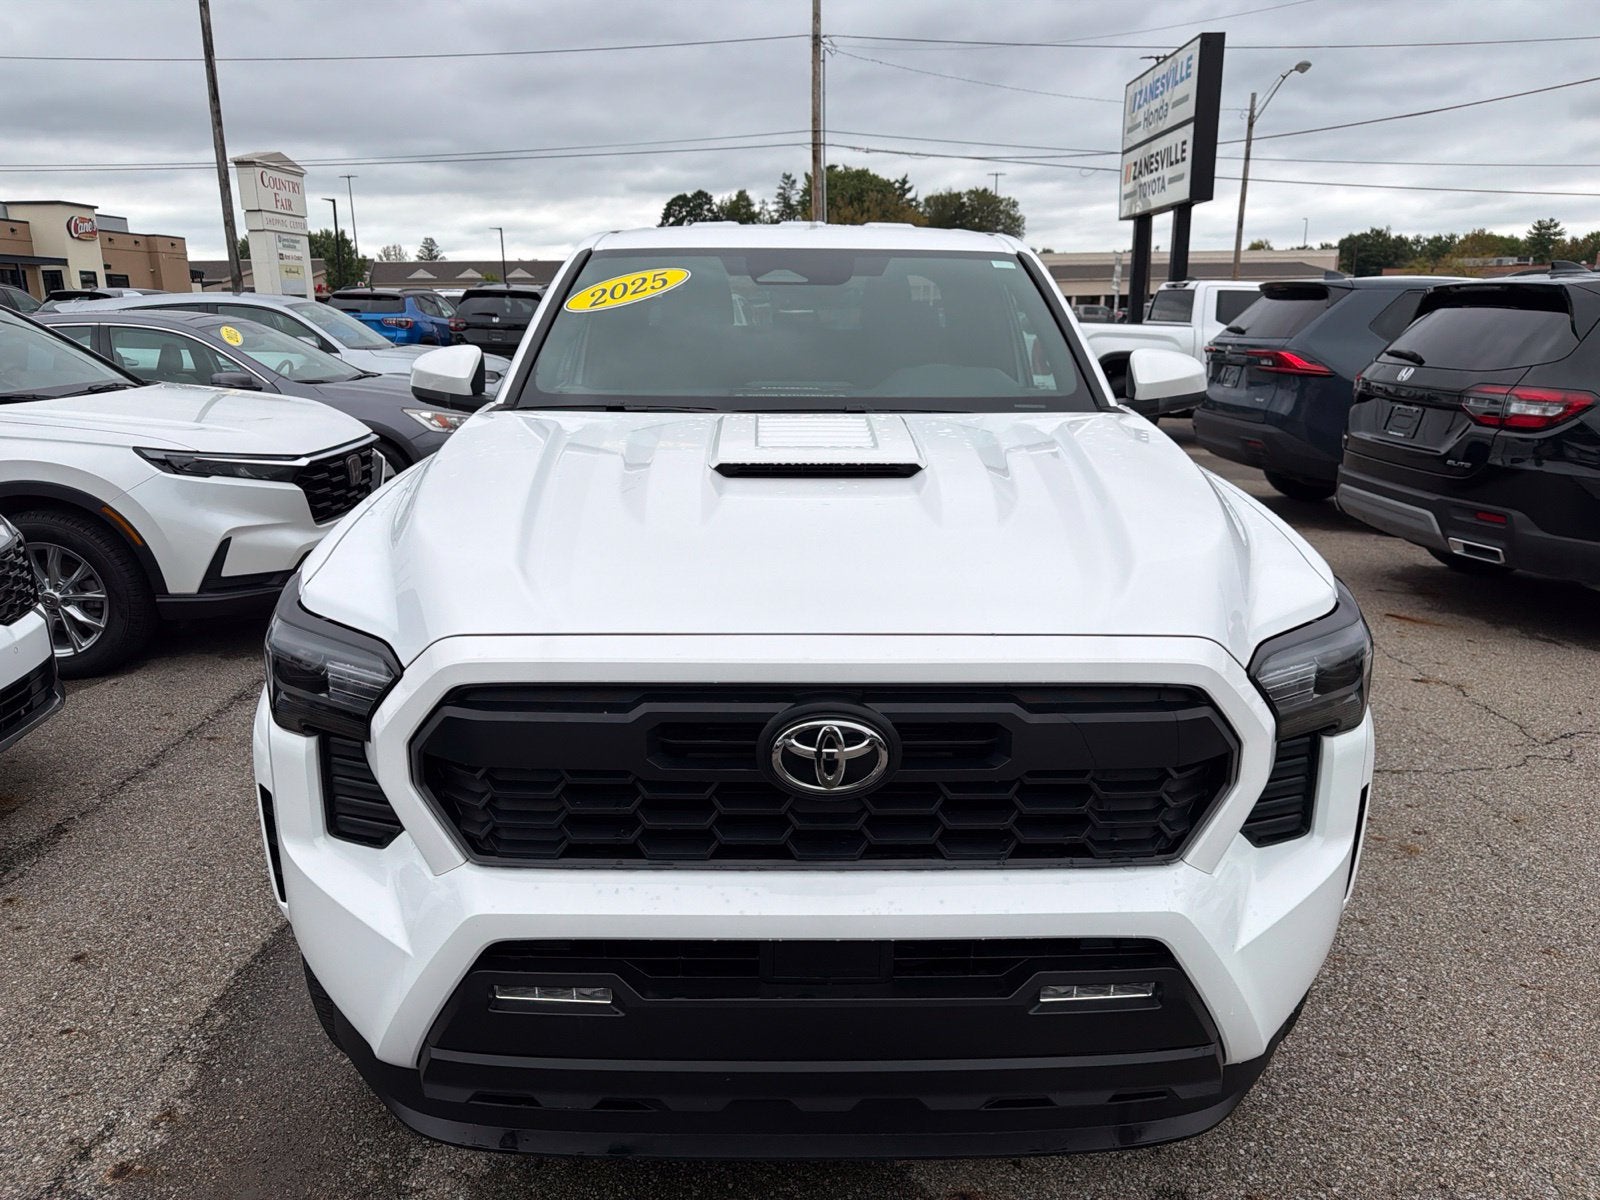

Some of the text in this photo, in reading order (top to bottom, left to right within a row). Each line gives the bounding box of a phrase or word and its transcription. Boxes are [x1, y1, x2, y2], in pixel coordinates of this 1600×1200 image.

[1137, 54, 1193, 108] ZANESVILLE
[1142, 100, 1169, 129] Honda
[1132, 140, 1187, 181] ZANESVILLE
[260, 171, 301, 195] COUNTRY
[1138, 176, 1166, 199] TOYOTA
[274, 193, 293, 211] FAIR
[265, 217, 307, 230] SHOPPING CENTER
[589, 271, 668, 308] 2025
